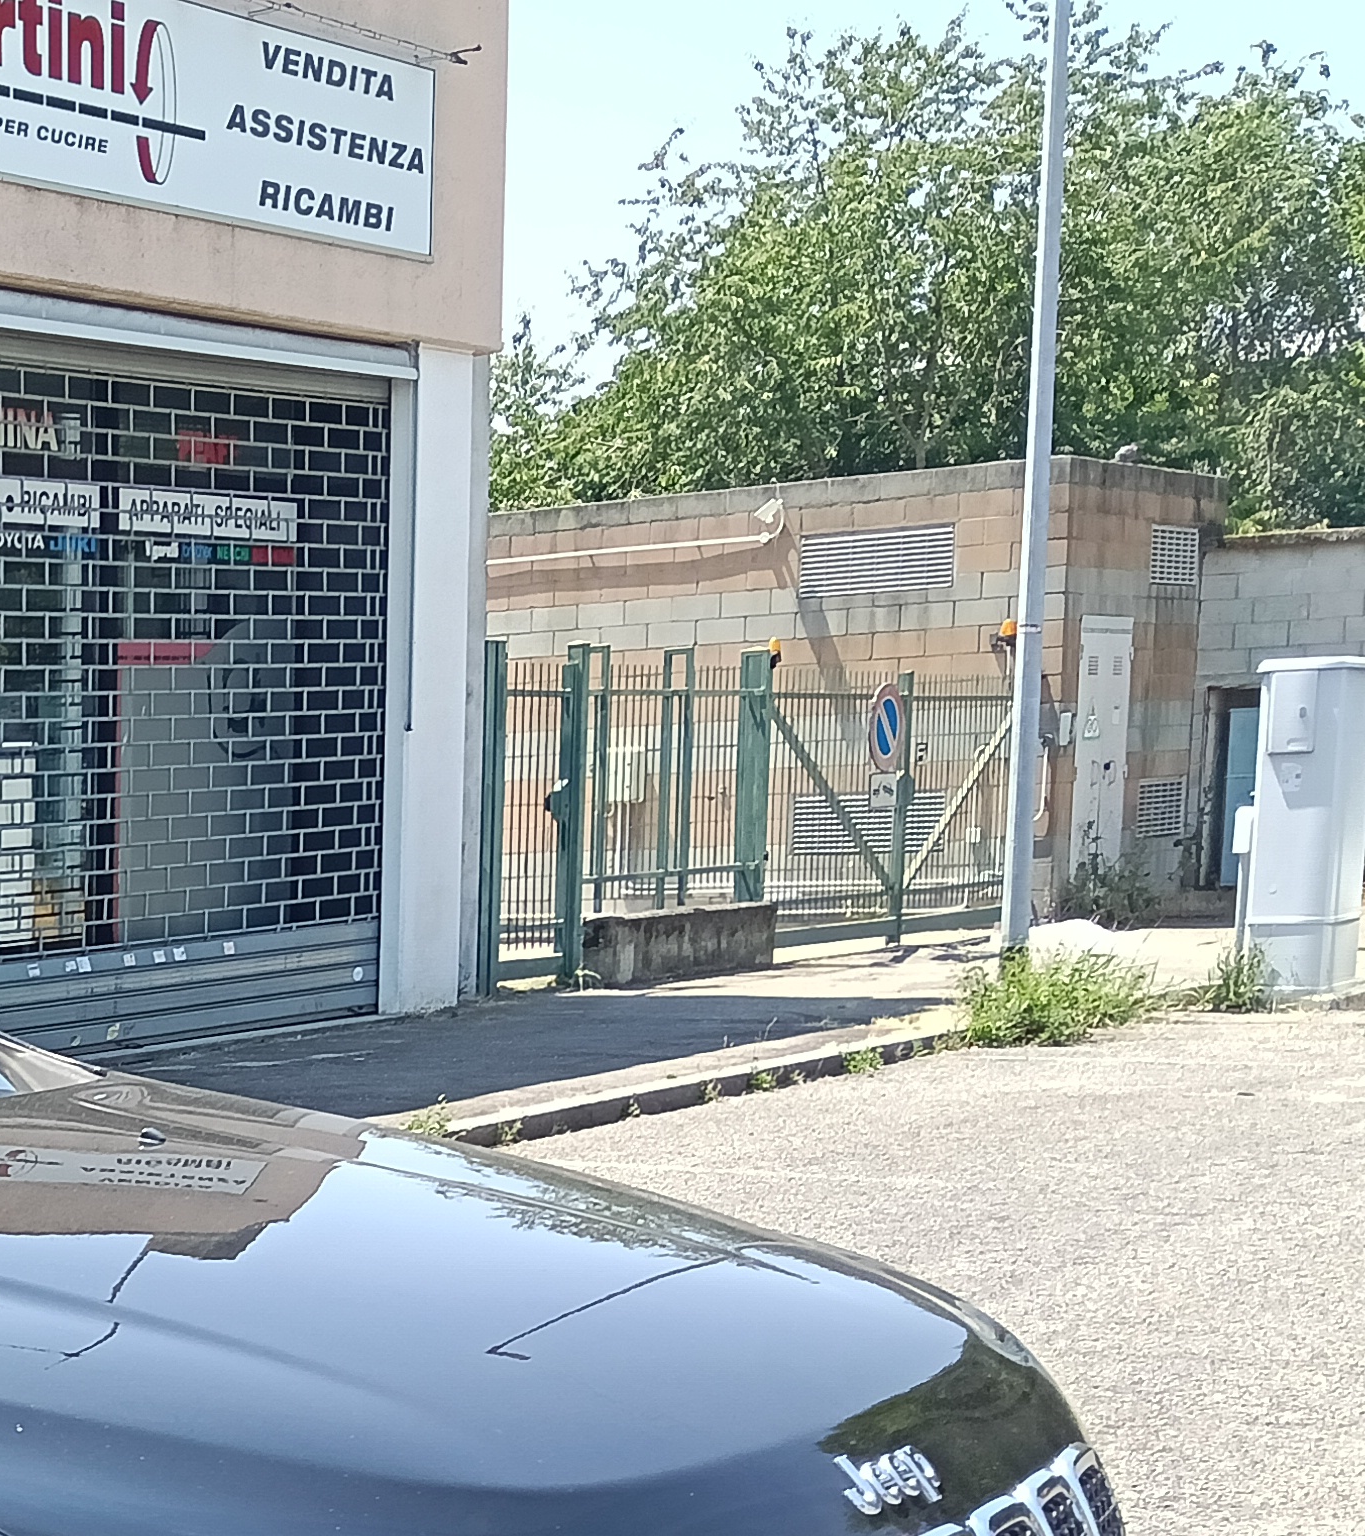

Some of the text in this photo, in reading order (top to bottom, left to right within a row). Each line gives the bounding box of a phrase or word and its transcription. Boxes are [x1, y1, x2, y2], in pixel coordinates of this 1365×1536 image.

[261, 41, 394, 102] VENDITA
[36, 125, 109, 154] CUCIRE
[225, 103, 425, 175] ASSISTENZA
[258, 179, 395, 233] RICAMBI
[21, 490, 93, 517] RICAMBI
[128, 497, 282, 532] APPARATI SPECIALI
[833, 1445, 943, 1515] Jeep
